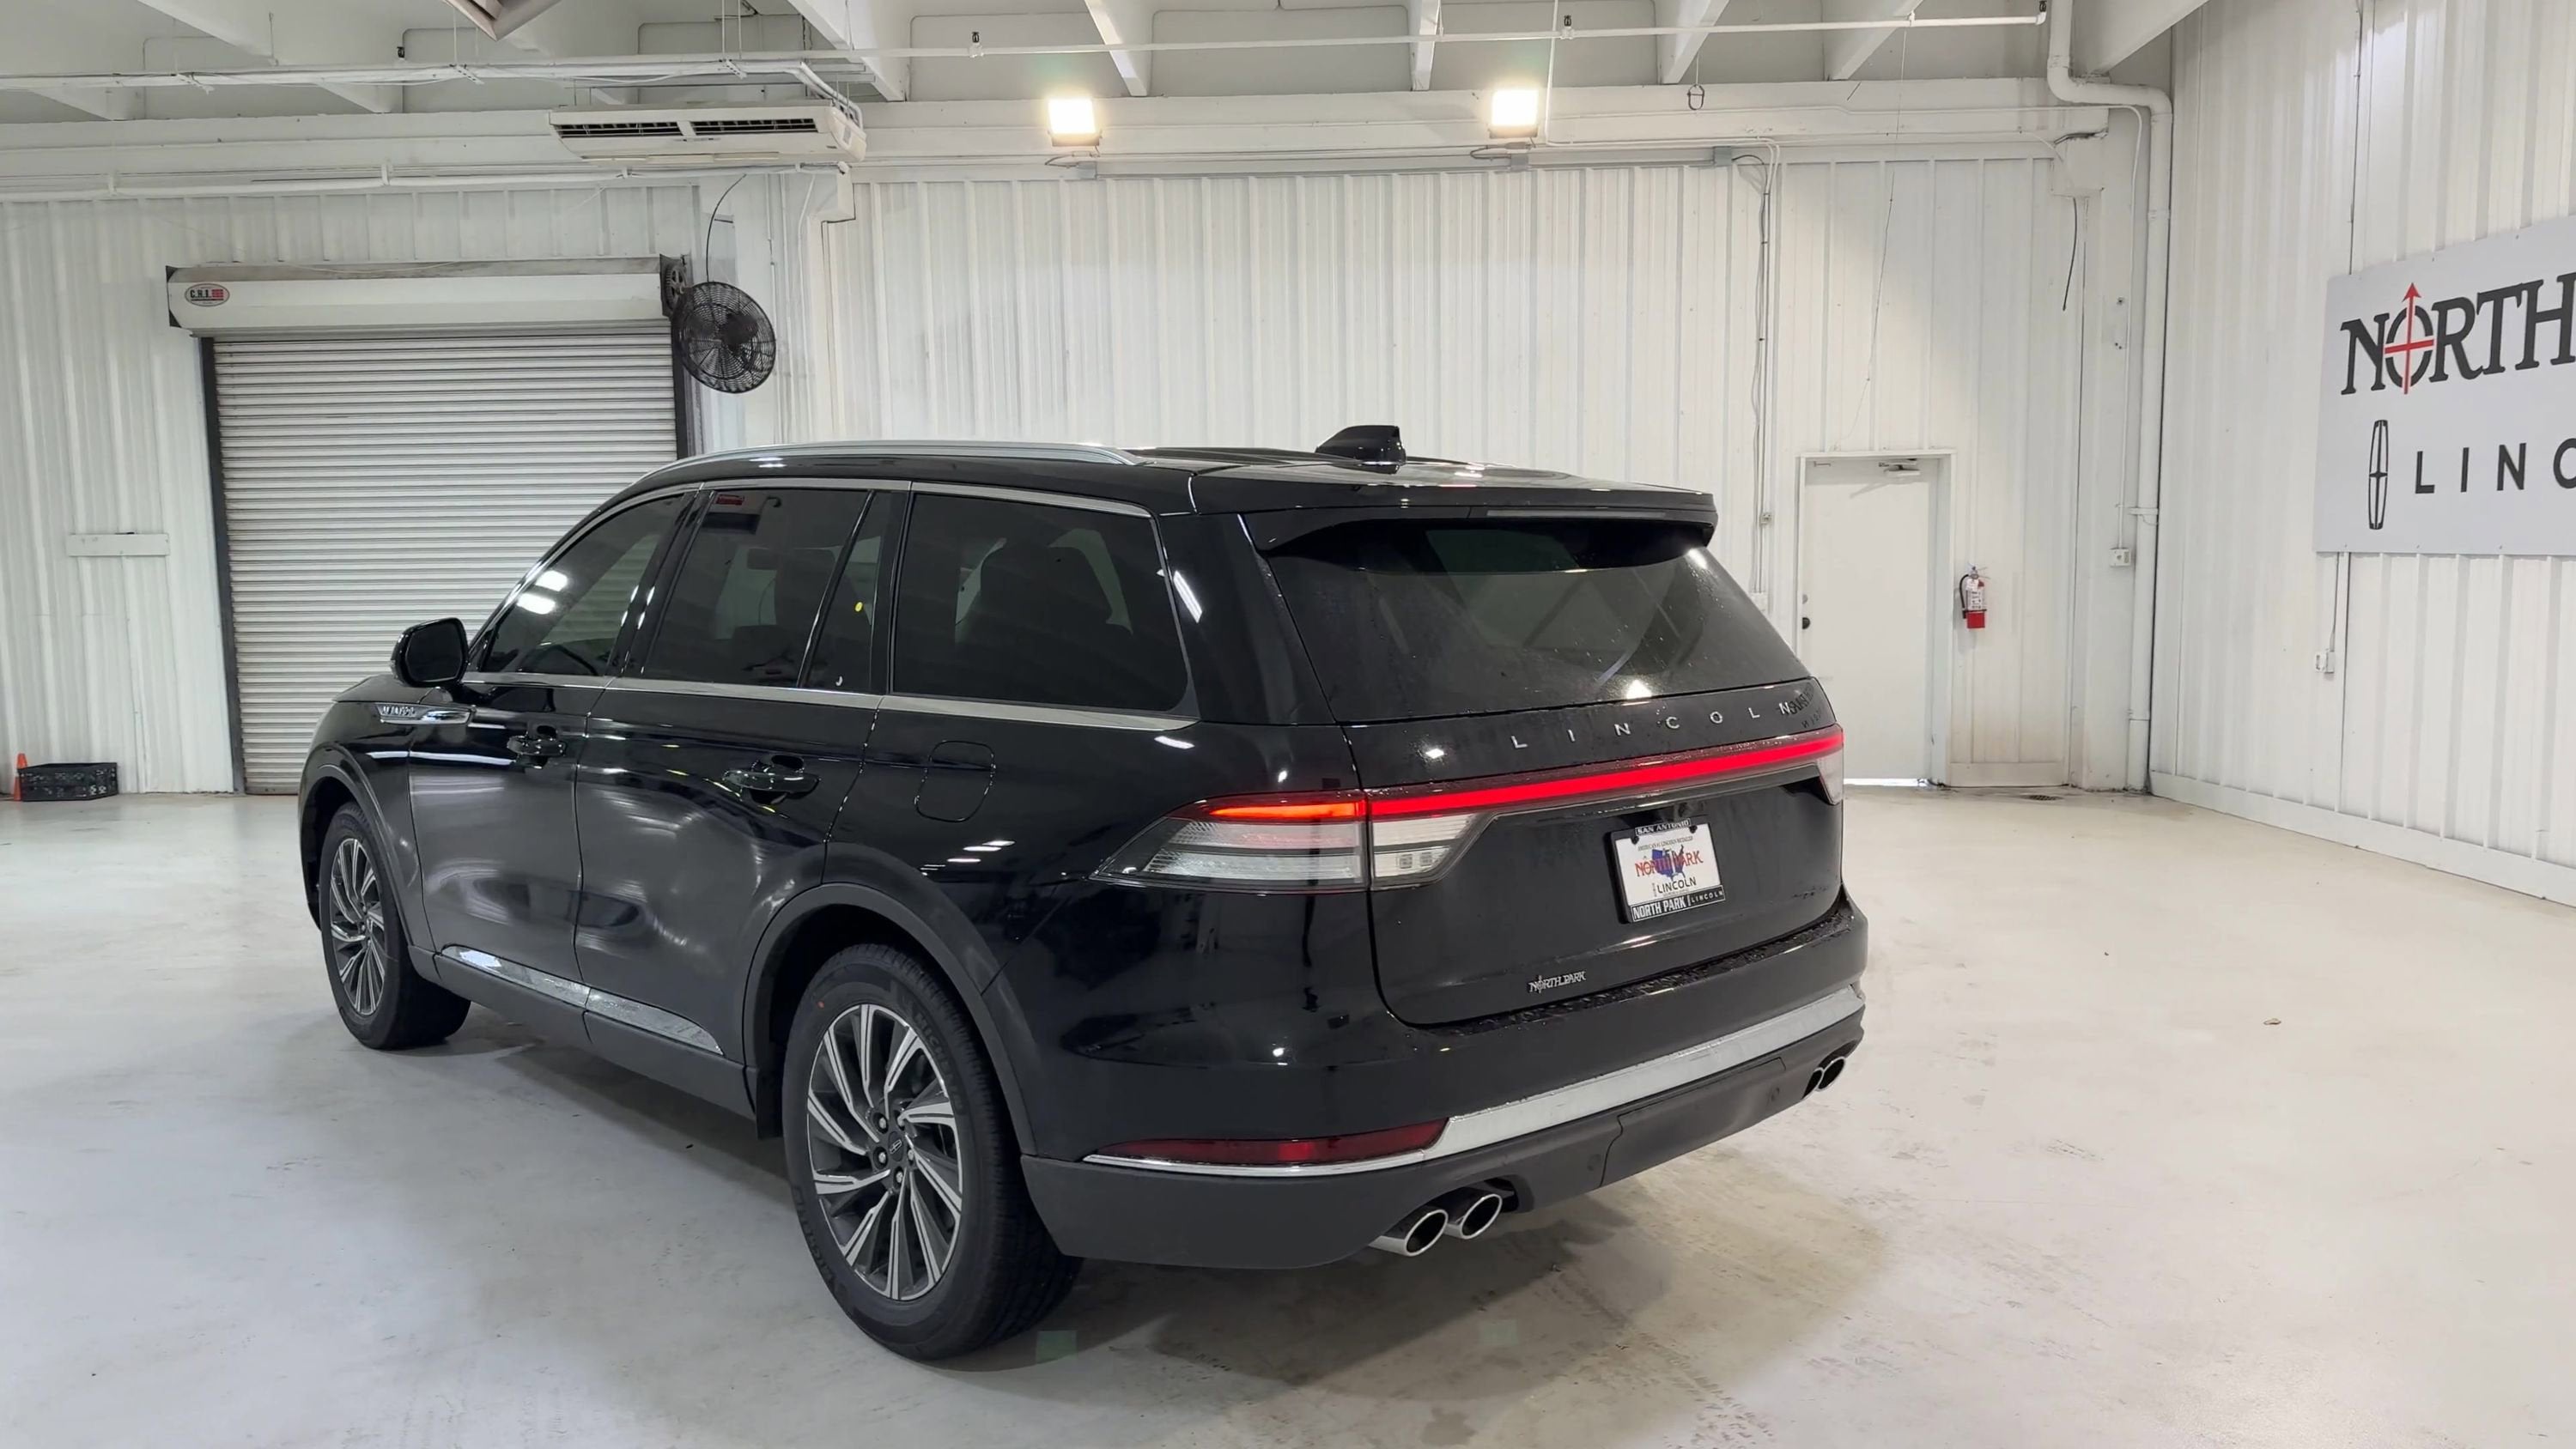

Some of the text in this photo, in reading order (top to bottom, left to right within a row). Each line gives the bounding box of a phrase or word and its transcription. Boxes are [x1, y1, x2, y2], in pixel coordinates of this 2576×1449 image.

[2340, 272, 2576, 395] NORTH
[1510, 700, 1790, 749] LINCOLN
[1637, 819, 1689, 835] SAN ANTONIO
[1656, 876, 1697, 894] LINCOLN
[1632, 901, 1662, 920] NORTH
[1662, 895, 1686, 912] PARK
[1691, 890, 1723, 903] LINCOLN
[1528, 971, 1587, 993] NORTH PARK
